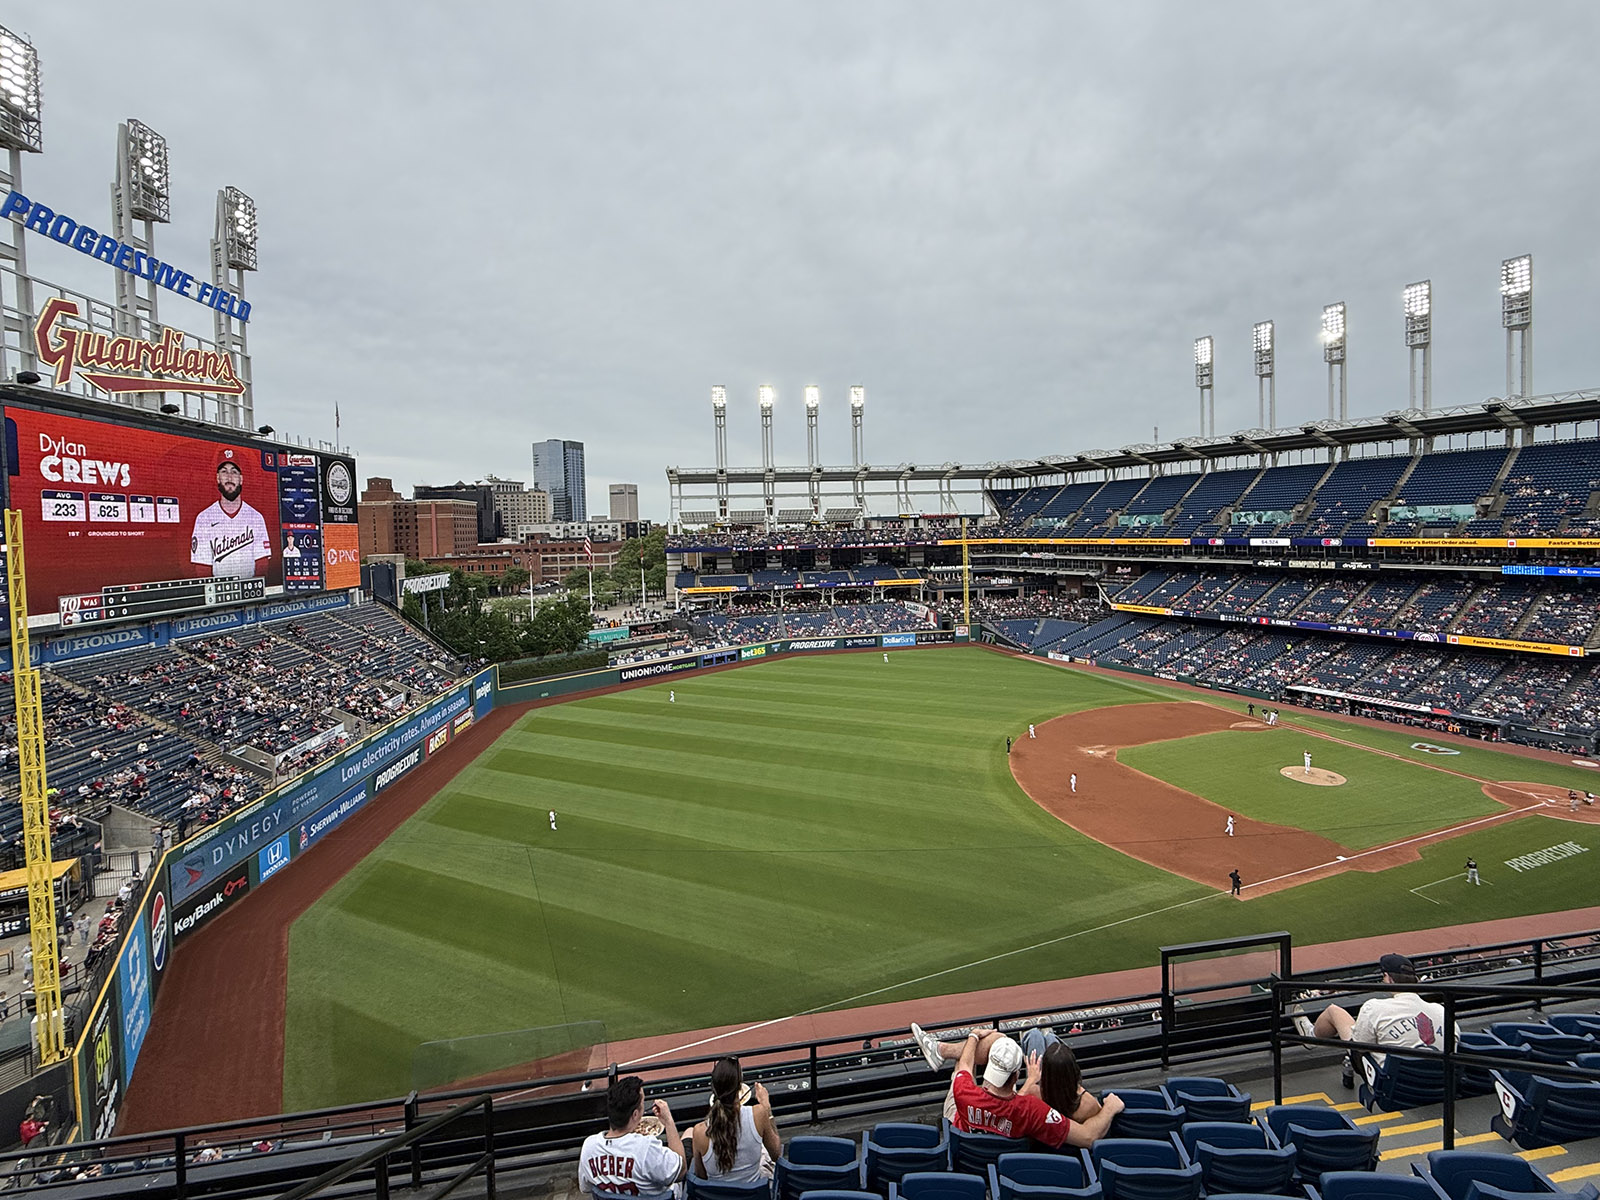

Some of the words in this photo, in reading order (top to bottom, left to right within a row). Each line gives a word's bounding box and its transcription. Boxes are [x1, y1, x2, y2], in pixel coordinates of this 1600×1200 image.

[0, 190, 195, 298] PROGRESSIVE
[198, 281, 252, 322] FIELD
[34, 298, 242, 389] Guardians
[39, 433, 87, 457] Dylan
[39, 455, 131, 487] CREWS
[52, 503, 77, 516] .233
[97, 505, 119, 518] .625
[139, 507, 144, 518] 1
[167, 508, 172, 519] 1
[209, 525, 254, 557] Nationals
[338, 548, 359, 563] PNC
[1288, 560, 1320, 568] CHAMPIONS
[1320, 561, 1336, 569] CLUB
[83, 598, 98, 606] WAS
[270, 601, 307, 616] HONDA
[315, 595, 346, 606] HONDA
[83, 611, 98, 620] CLE
[188, 612, 239, 631] HONDA
[72, 629, 143, 652] HONDA
[789, 640, 837, 650] PROGRESSIVE
[882, 636, 915, 644] DollarBank
[741, 646, 766, 658] bet365
[672, 661, 697, 671] MORTGAGE
[475, 681, 492, 700] meijer
[341, 761, 361, 782] Low
[361, 736, 401, 769] electricity
[401, 725, 420, 744] rates.
[420, 711, 442, 732] Always
[441, 706, 448, 718] in
[447, 696, 467, 714] season.
[374, 748, 421, 792] PROGRESSIVE
[277, 777, 304, 798] PROGRESSIVE
[291, 786, 318, 807] POWERED
[235, 800, 267, 823] PROGRESSIVE
[310, 789, 367, 837] SHERWIN-WILLIAMS
[182, 825, 222, 854] PROGRESSIVE
[212, 808, 282, 866] DYNEGY
[262, 856, 289, 879] HONDA
[1503, 841, 1590, 873] PROGRESSIVE
[174, 891, 225, 936] KeyBank
[1501, 1091, 1511, 1108] C
[967, 1105, 1013, 1137] NAYLOR
[588, 1154, 635, 1179] BIEBER
